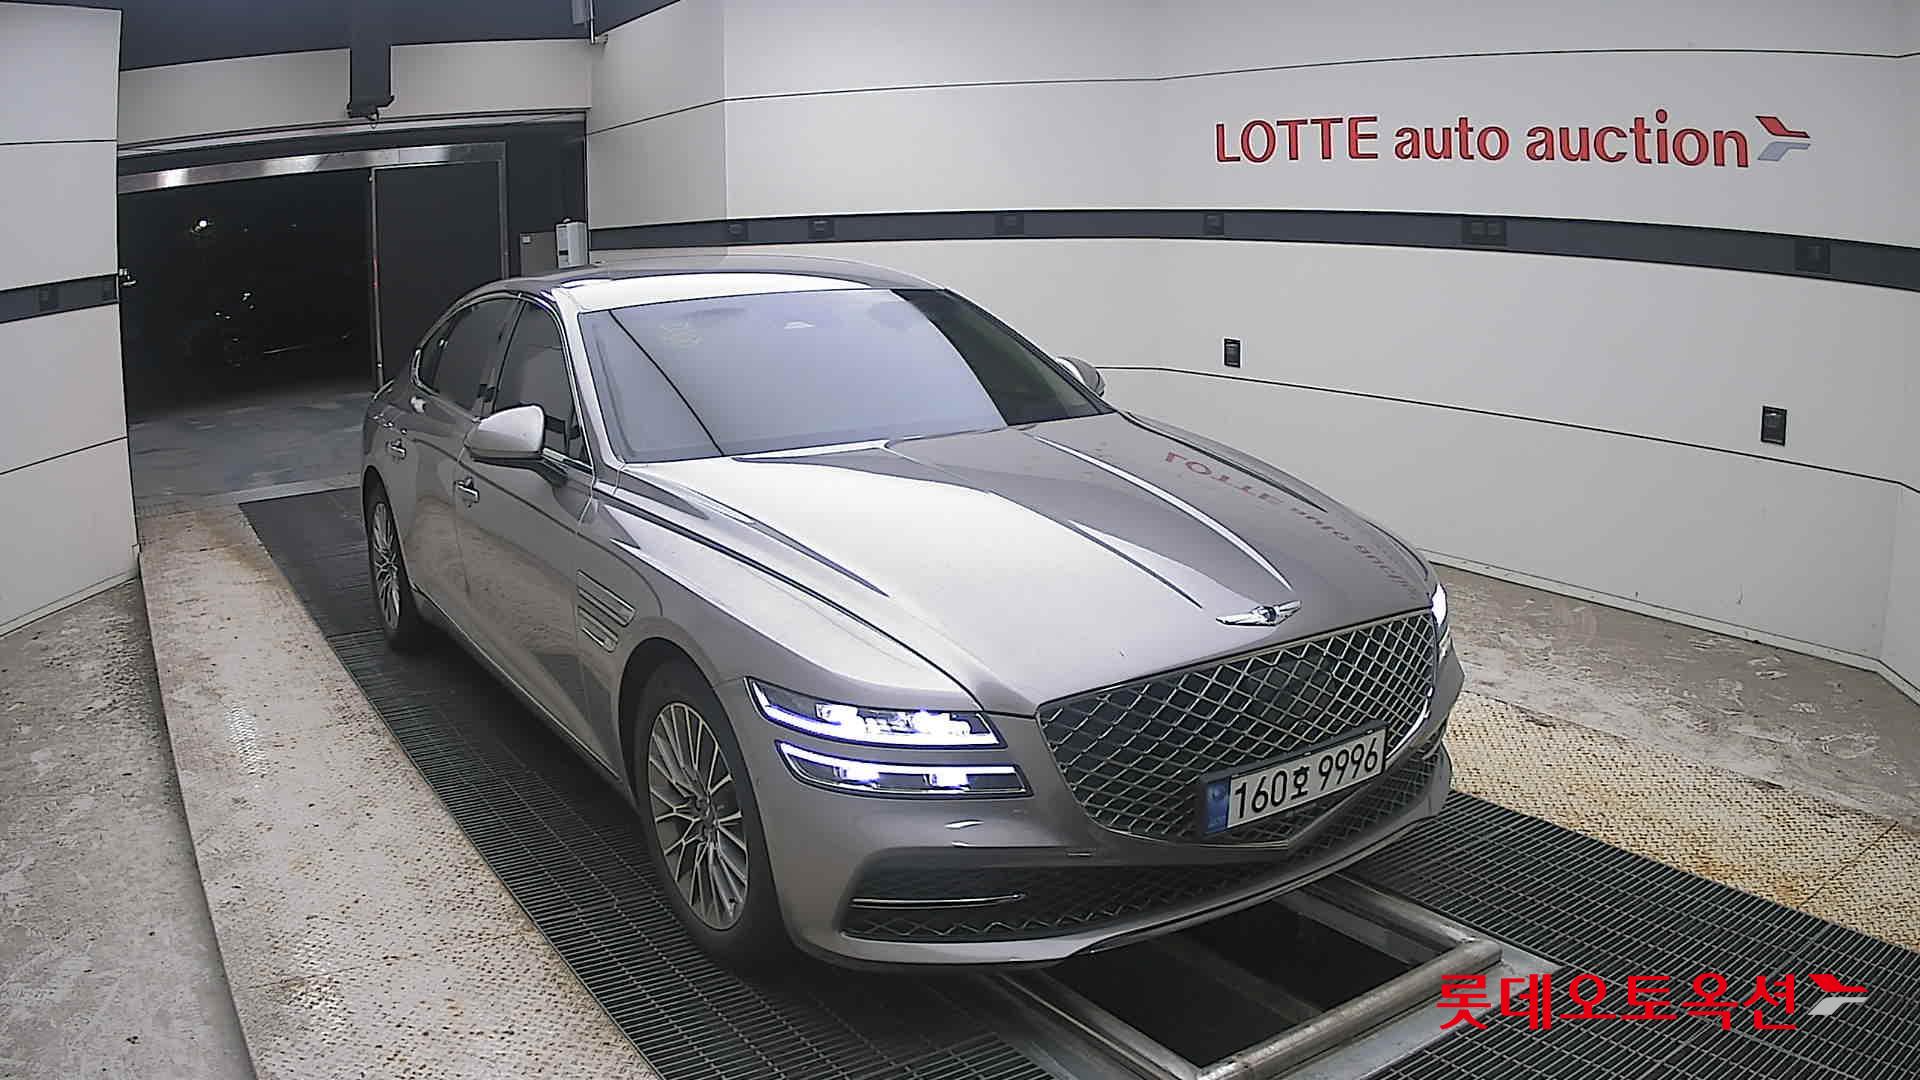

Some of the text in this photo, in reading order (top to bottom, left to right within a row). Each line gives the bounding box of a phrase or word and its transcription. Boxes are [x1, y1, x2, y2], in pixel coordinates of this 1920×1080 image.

[1216, 109, 1750, 168] LOTTE auto auction
[1235, 737, 1378, 818] 160호 9996
